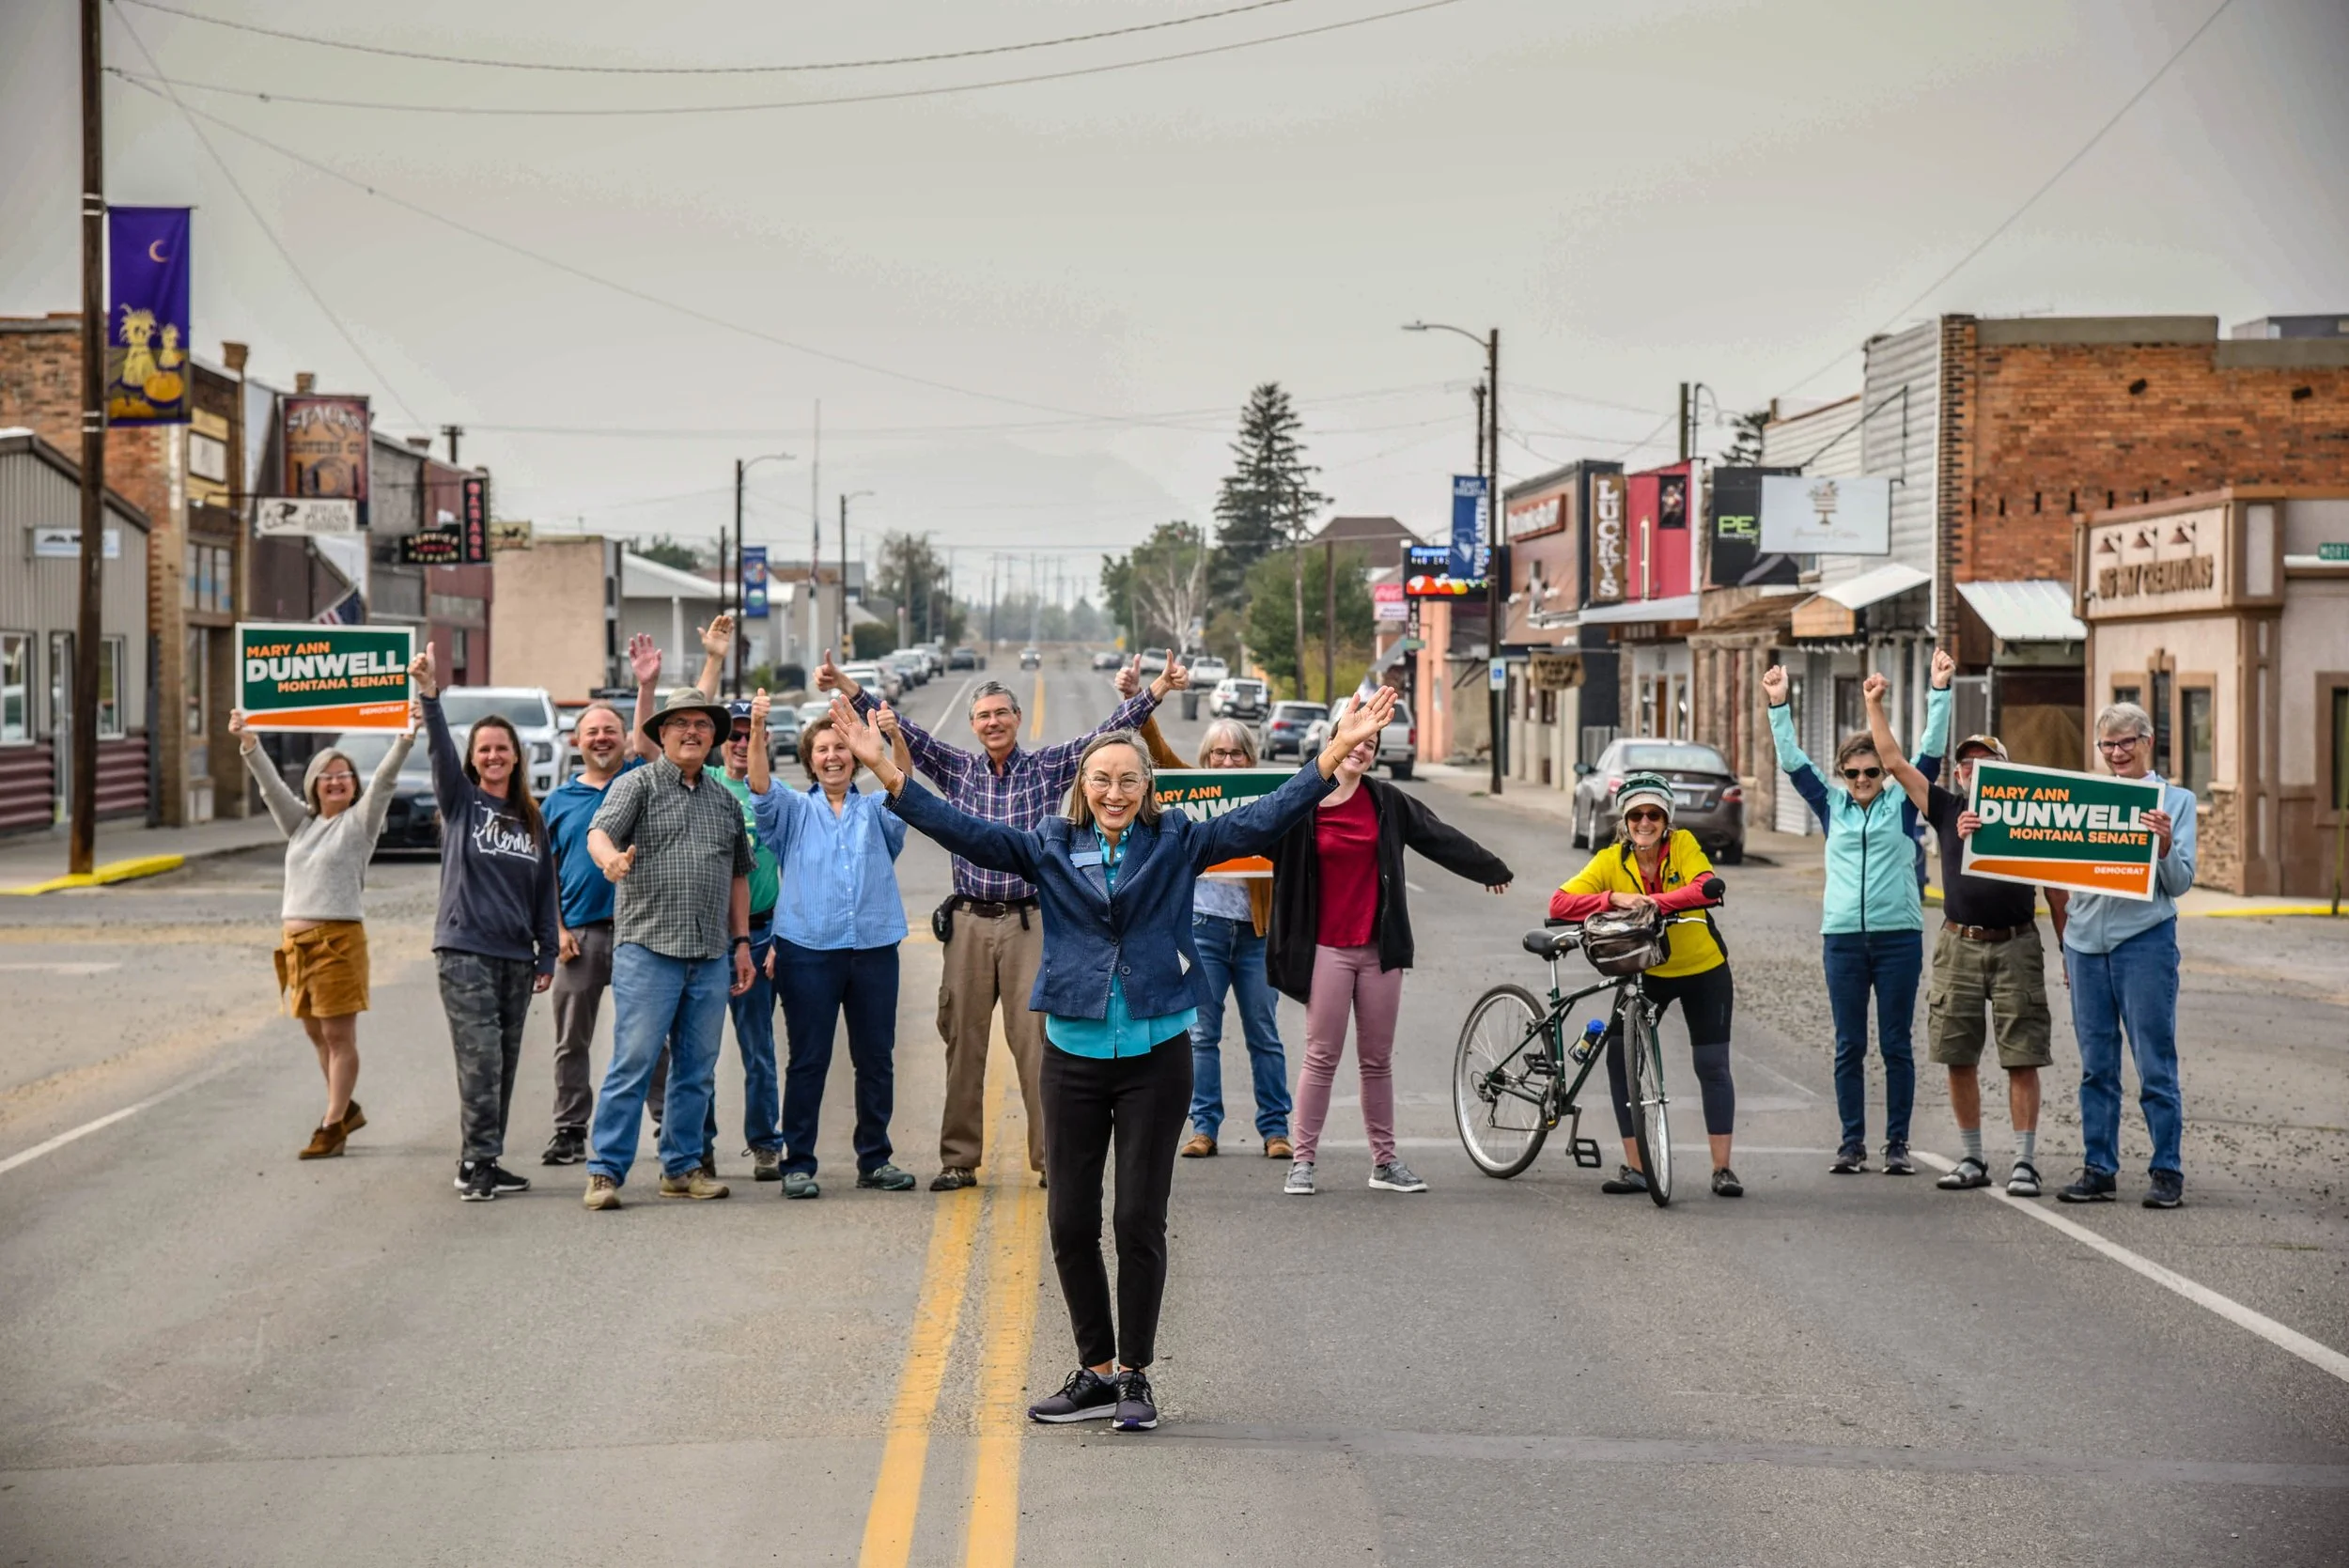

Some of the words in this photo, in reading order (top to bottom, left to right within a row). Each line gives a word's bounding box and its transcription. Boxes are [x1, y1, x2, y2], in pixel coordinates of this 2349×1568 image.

[287, 404, 364, 435] STACKS
[466, 481, 482, 559] GARAGE
[246, 644, 291, 659] MARY
[295, 642, 331, 655] ANN
[245, 650, 406, 683] DUNWELL
[277, 677, 349, 693] MONTANA
[350, 674, 405, 689] SENATE
[359, 705, 405, 716] DEMOCRAT
[1155, 789, 1185, 803] ARY
[1188, 785, 1221, 800] ANN
[1981, 785, 2029, 800] MARY
[2031, 788, 2070, 801] ANN
[1979, 800, 2149, 831] DUNWELL
[2009, 828, 2084, 843] MONTANA
[2088, 831, 2148, 846] SENATE
[2093, 865, 2145, 876] DEMOCRAT
